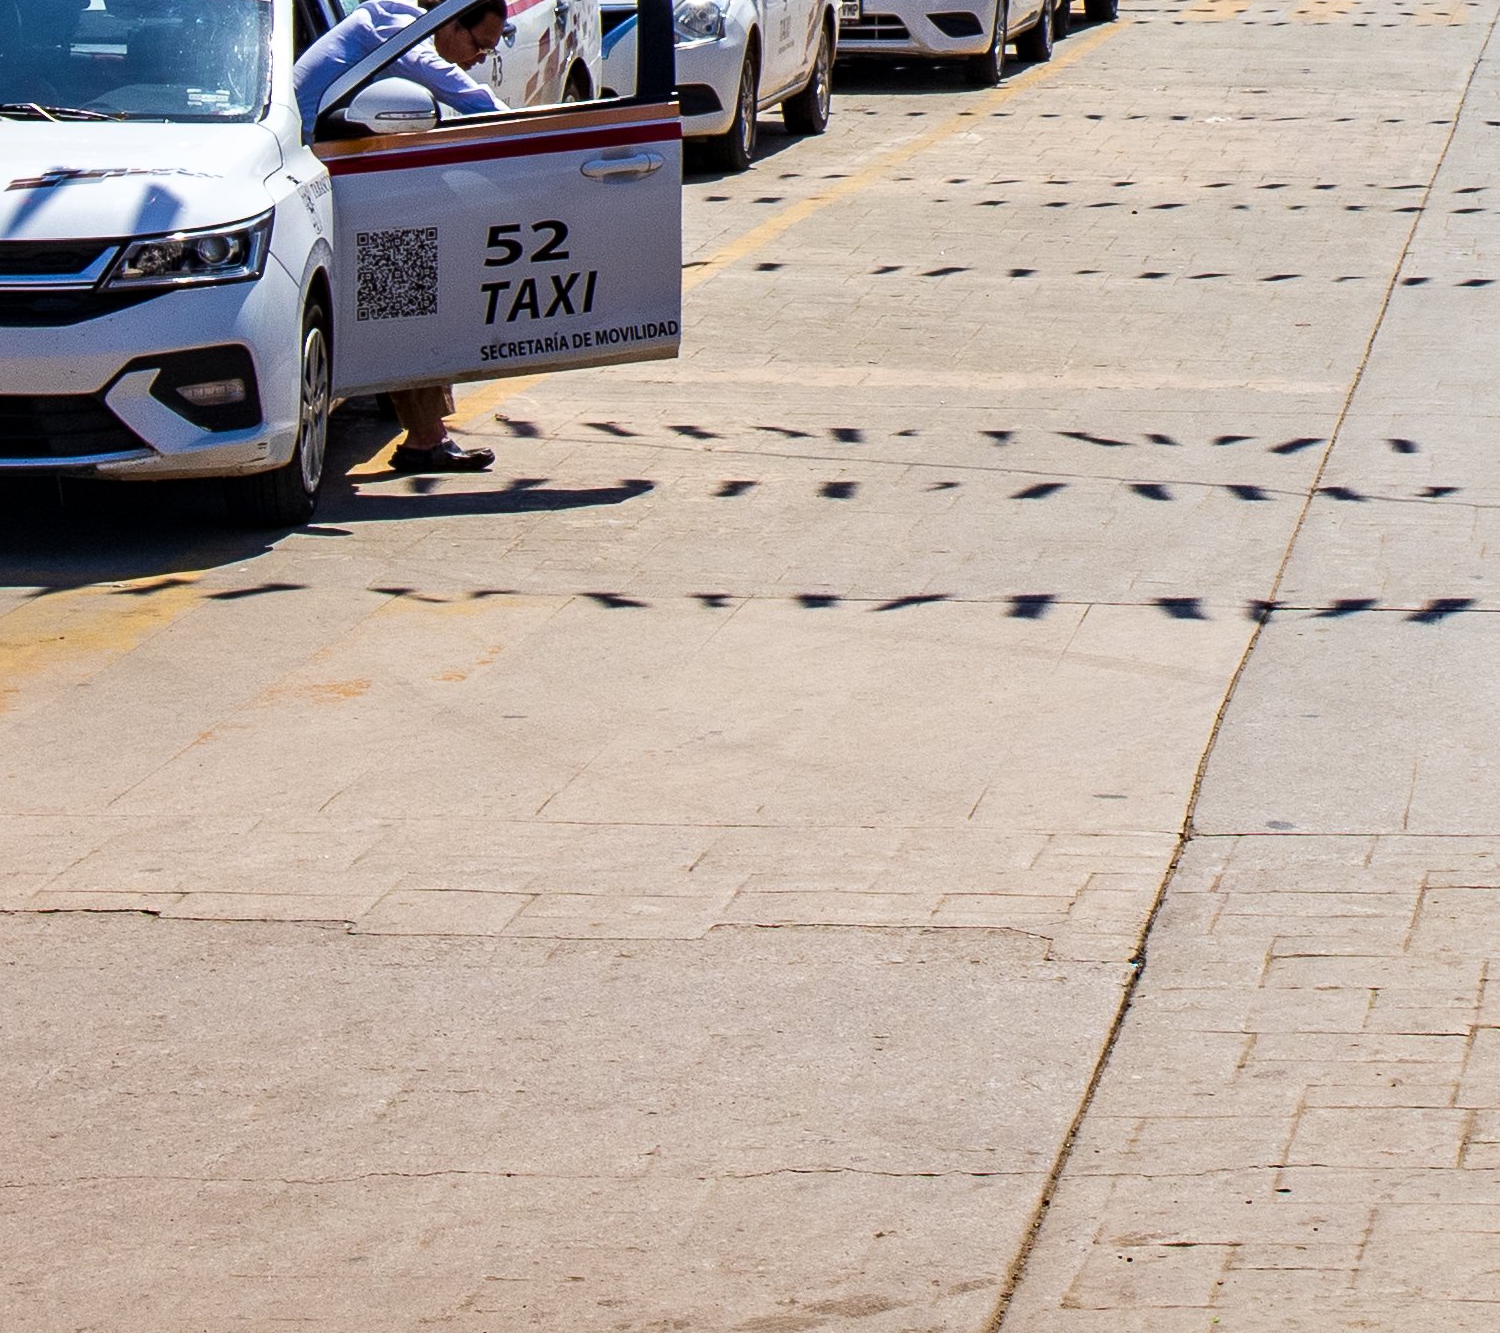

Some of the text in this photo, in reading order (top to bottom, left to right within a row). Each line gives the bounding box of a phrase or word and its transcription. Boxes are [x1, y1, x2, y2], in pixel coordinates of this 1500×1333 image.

[484, 220, 569, 267] 52
[481, 270, 597, 325] TAXI
[480, 320, 679, 361] SECRETARÍA DE MOVILIDAD
